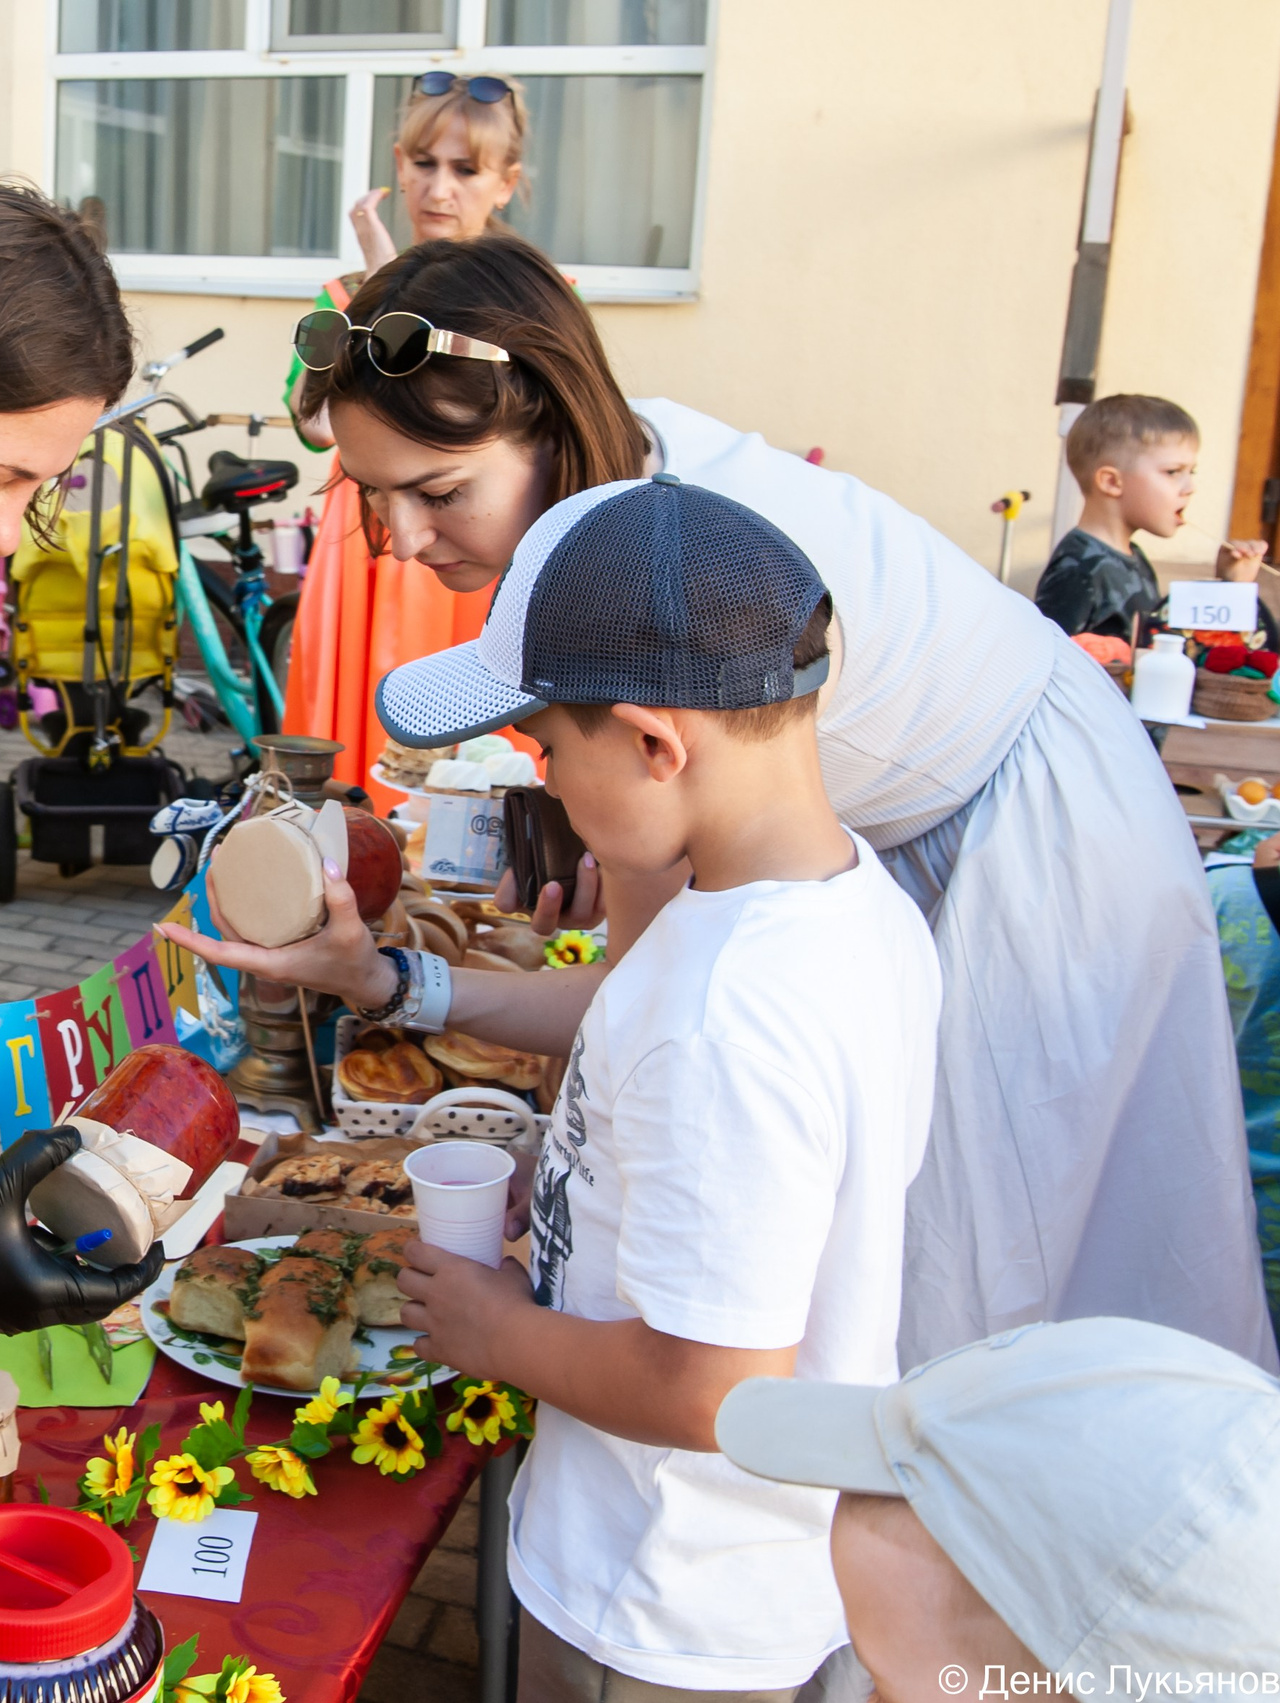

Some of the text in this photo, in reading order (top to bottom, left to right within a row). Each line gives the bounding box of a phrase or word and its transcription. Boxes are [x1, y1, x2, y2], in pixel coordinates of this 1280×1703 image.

[1191, 606, 1231, 625] 150
[471, 814, 504, 837] 50
[191, 1535, 233, 1578] 100
